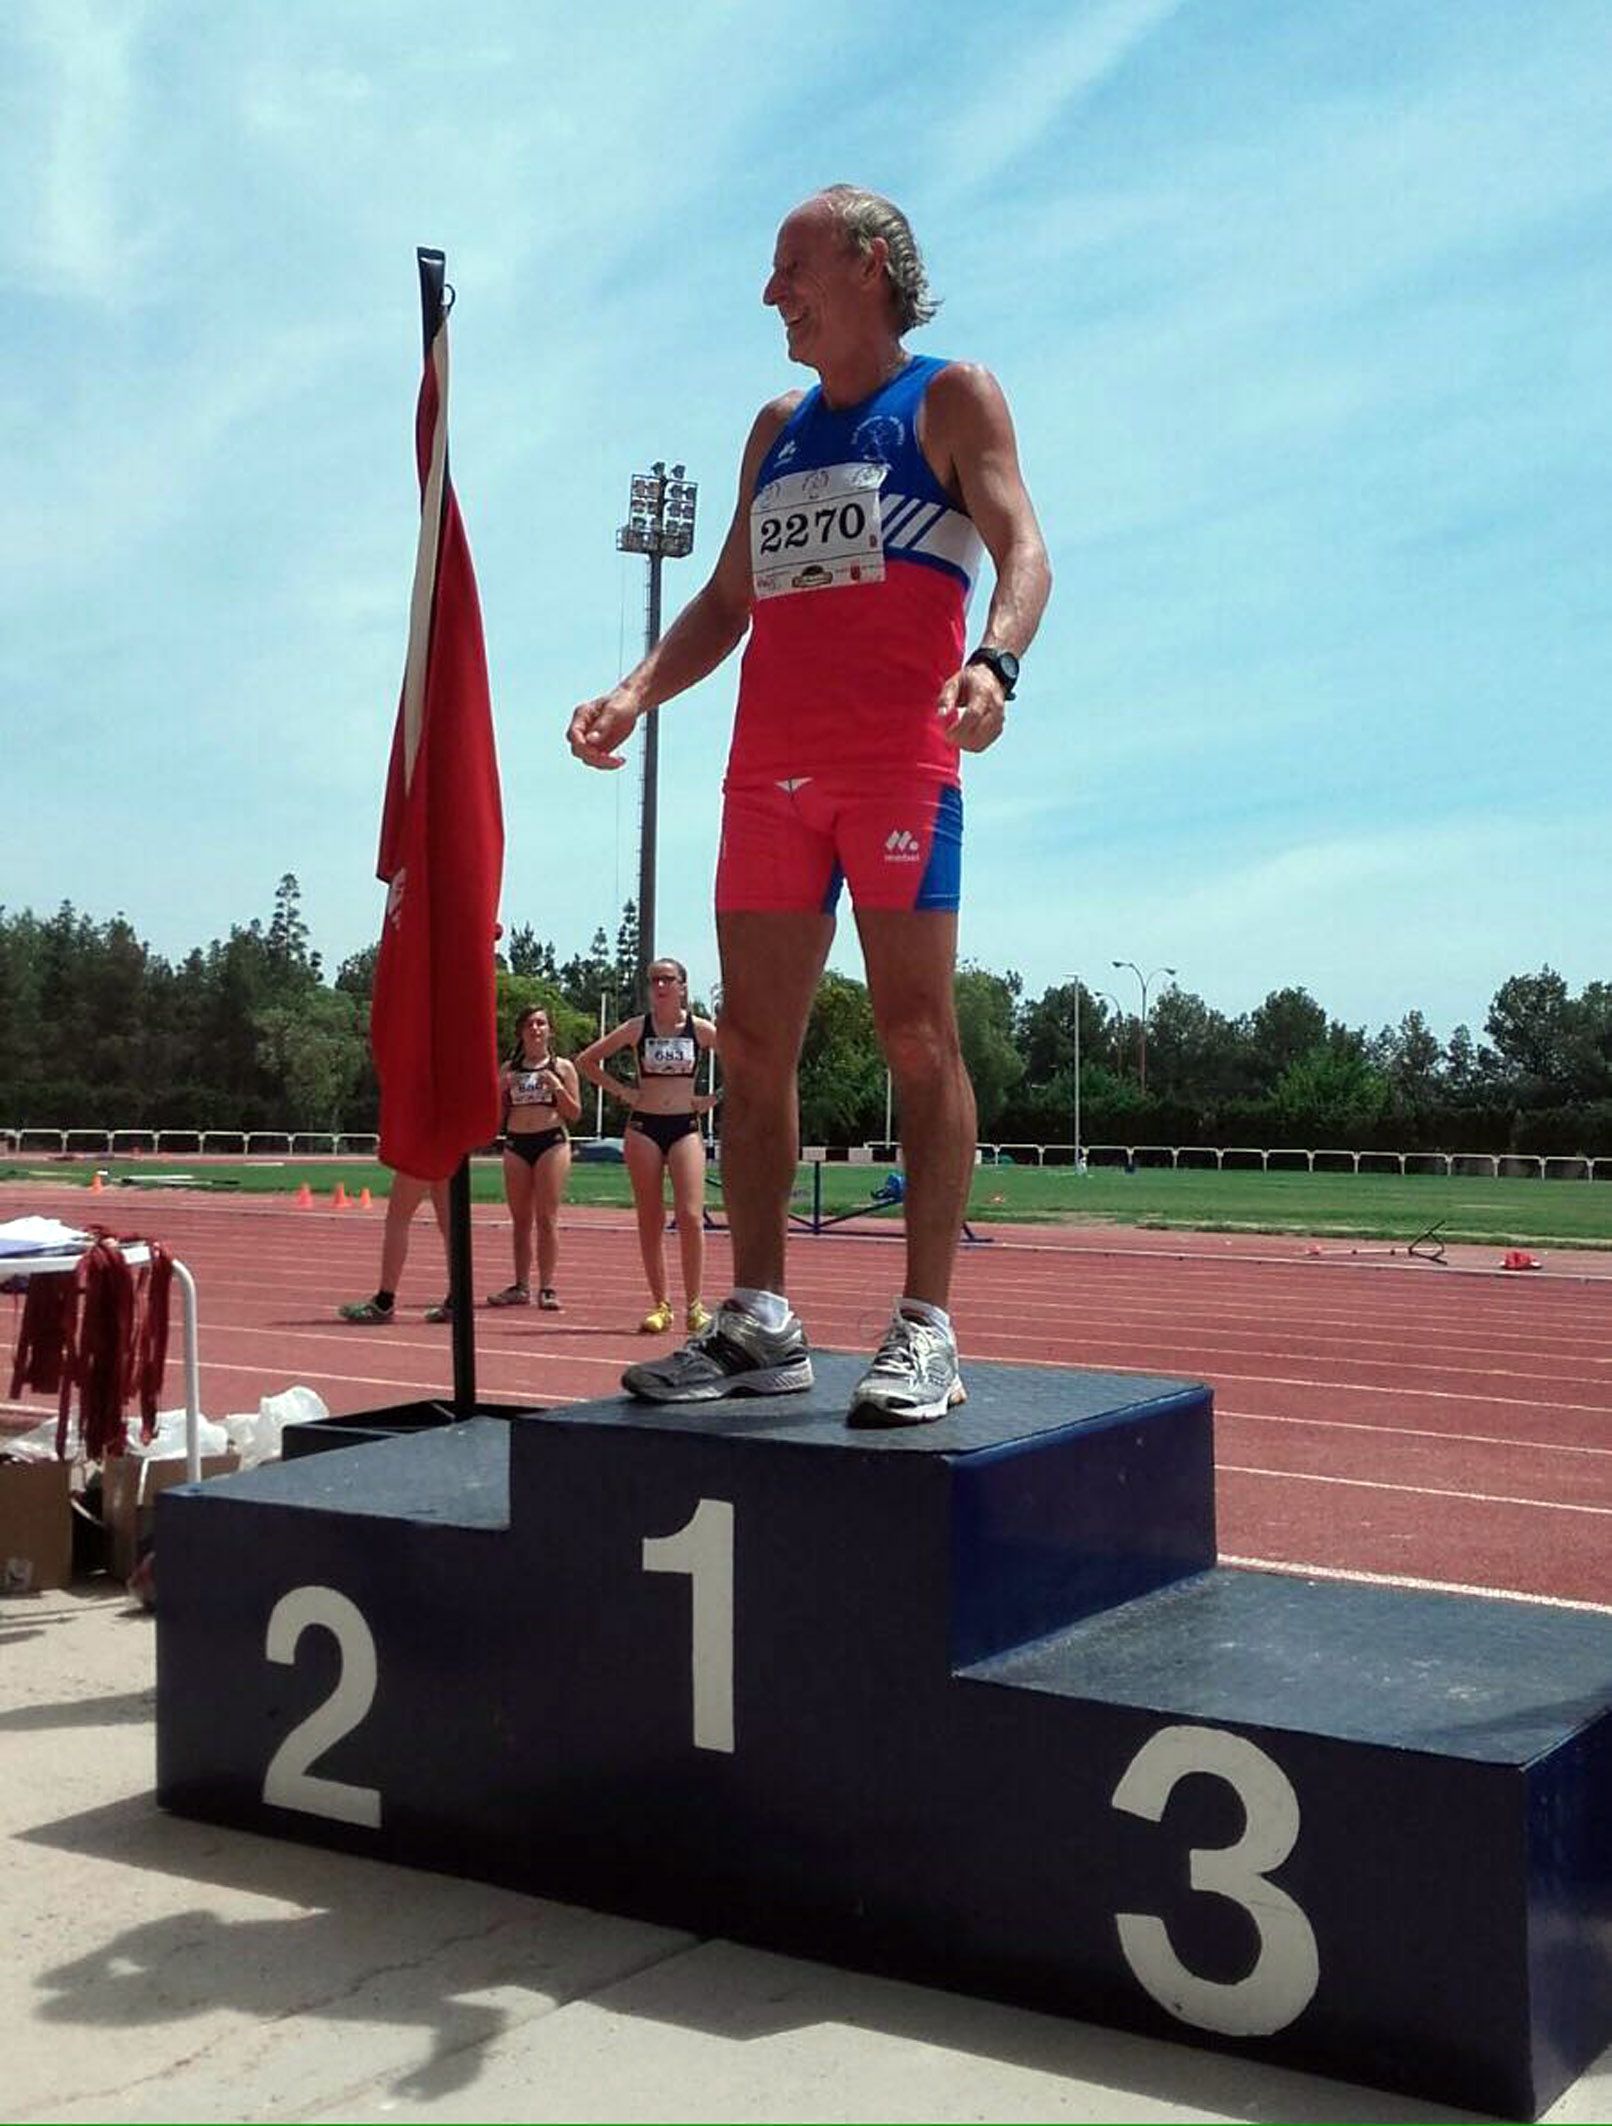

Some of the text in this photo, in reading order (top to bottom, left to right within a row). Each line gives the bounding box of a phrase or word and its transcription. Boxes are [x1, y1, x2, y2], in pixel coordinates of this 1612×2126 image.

[760, 503, 865, 556] 2270
[264, 1585, 381, 1829] 2
[642, 1498, 734, 1753] 1
[1111, 1725, 1320, 2036] 3
